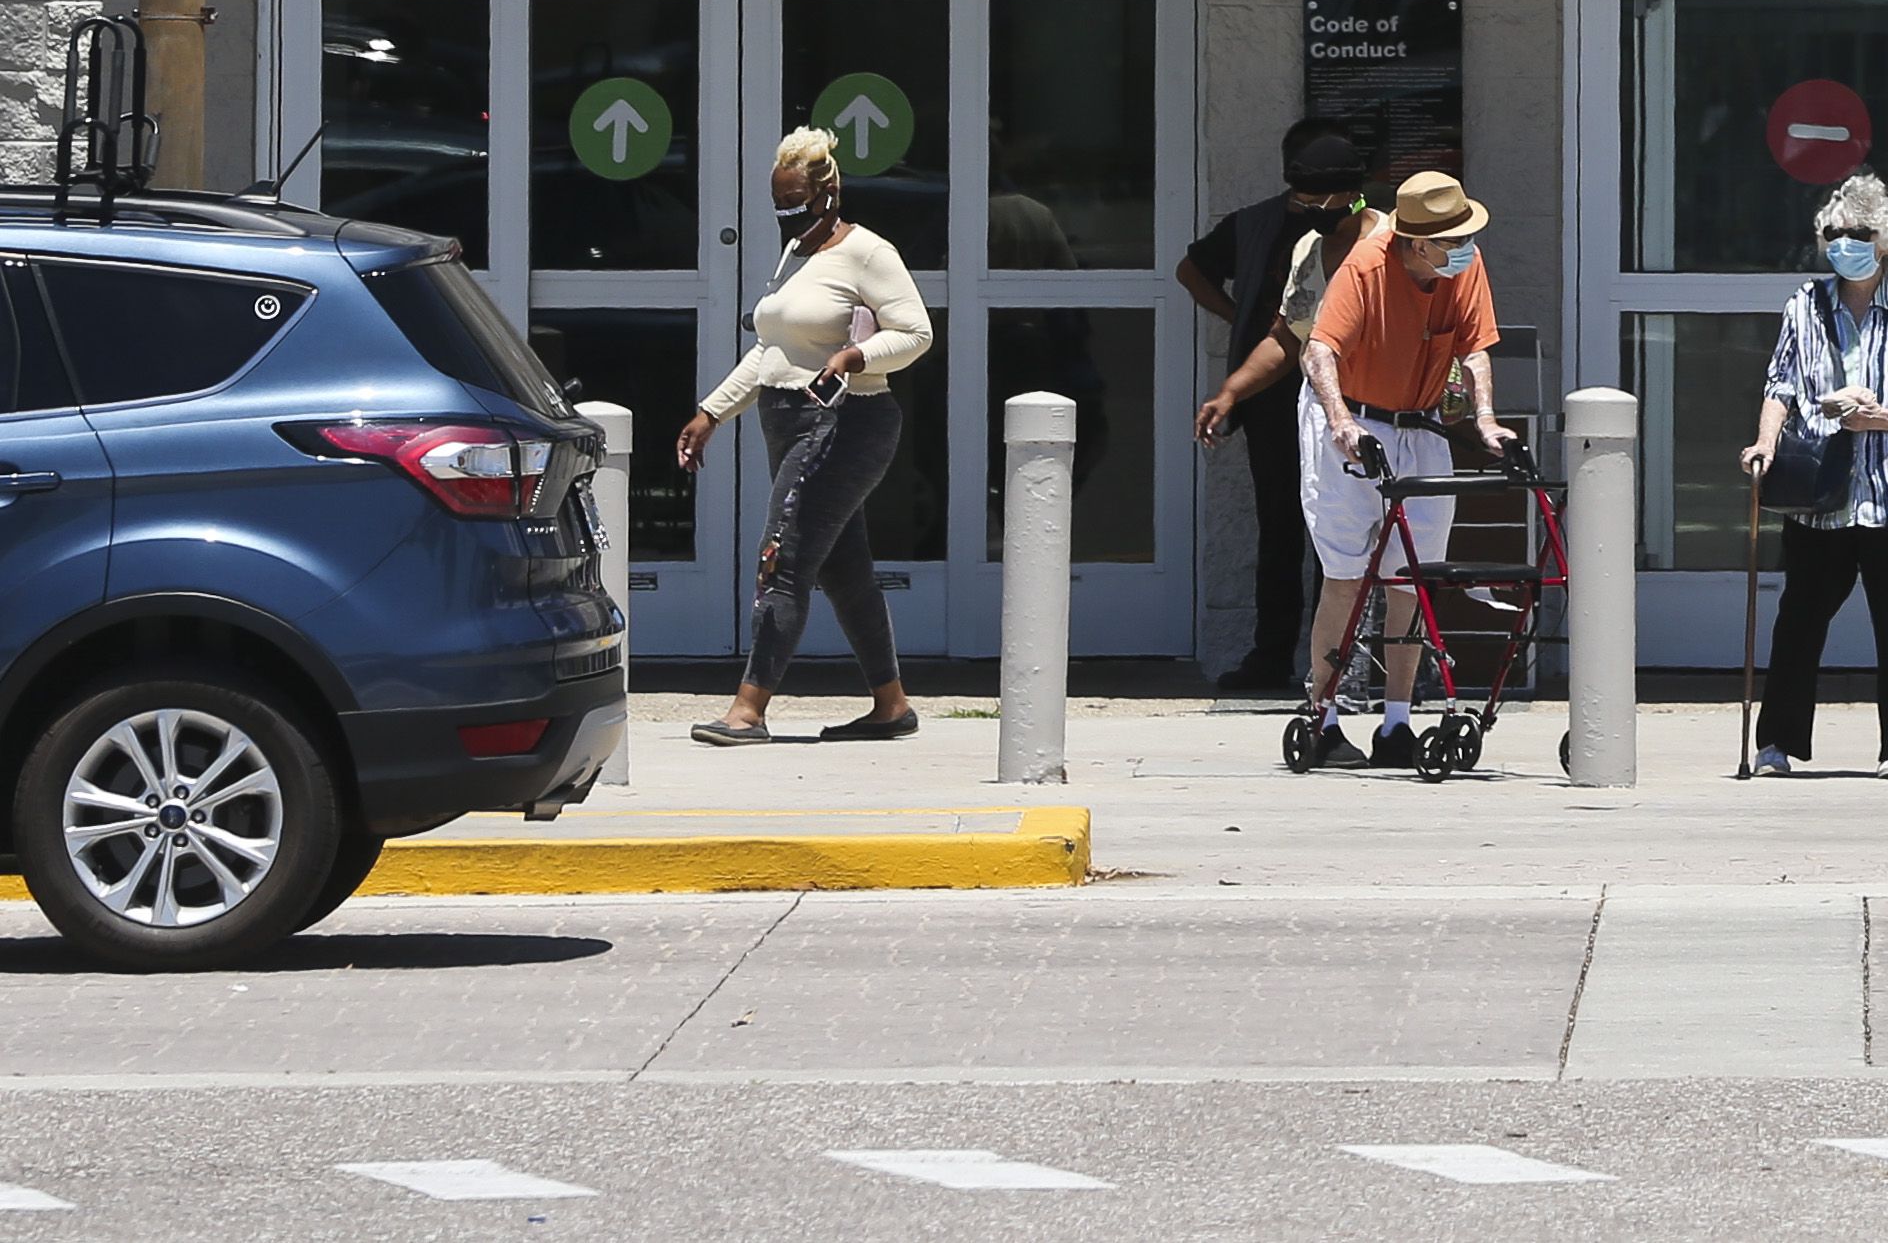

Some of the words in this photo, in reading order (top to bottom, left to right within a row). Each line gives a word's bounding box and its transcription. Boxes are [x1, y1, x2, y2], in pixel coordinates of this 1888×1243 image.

[1309, 16, 1369, 33] Code
[1376, 15, 1399, 33] of
[1309, 41, 1407, 58] Conduct
